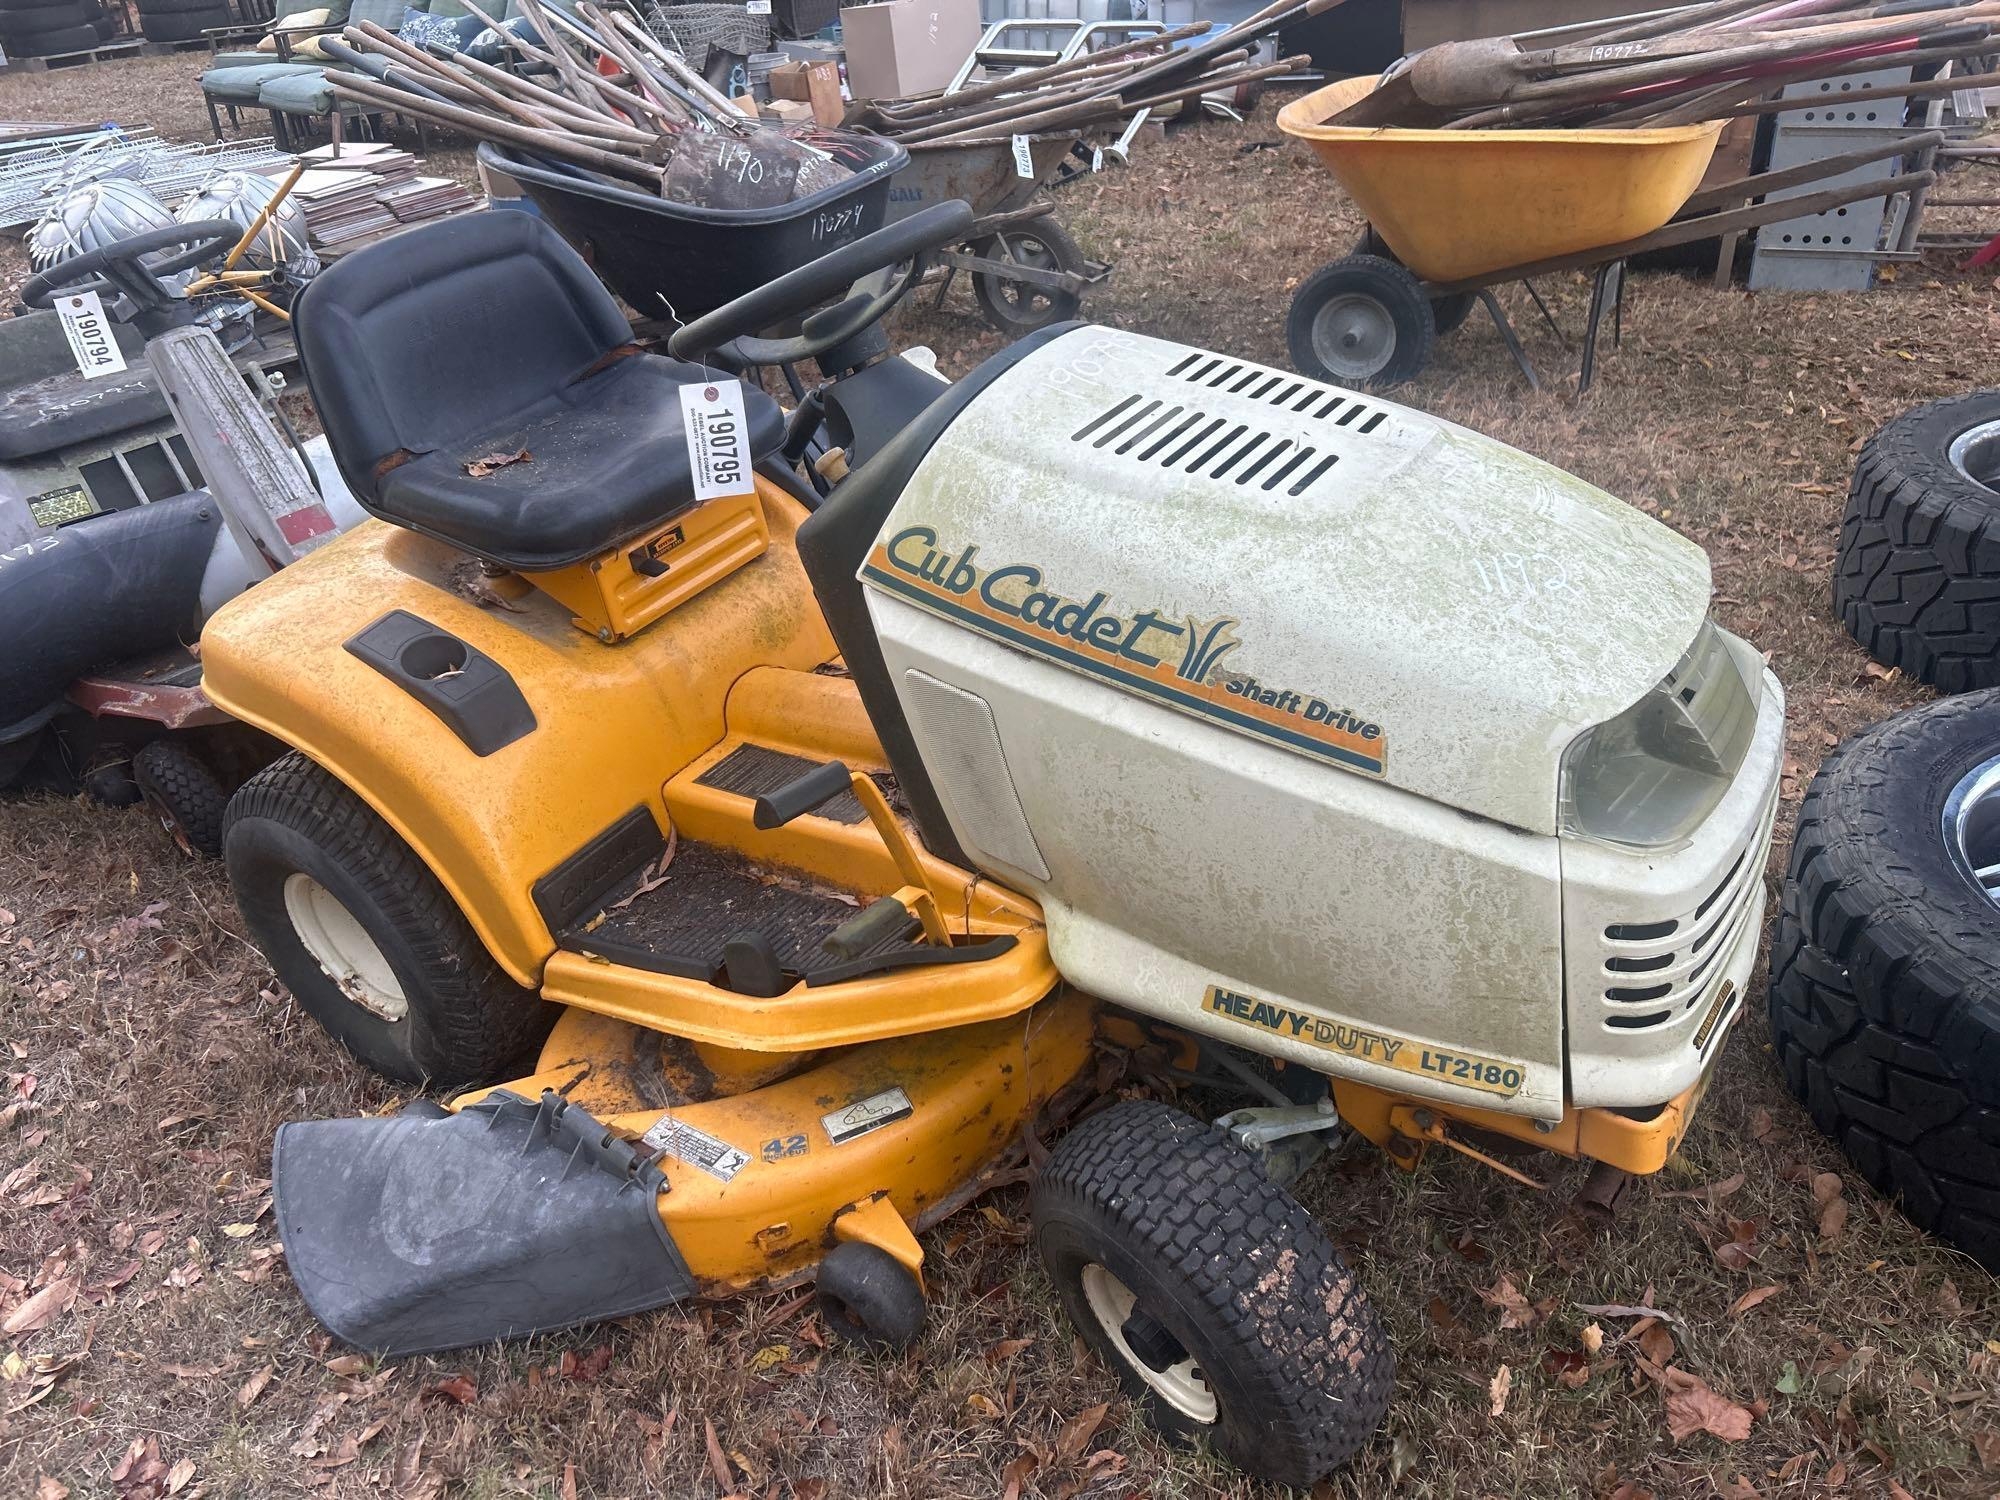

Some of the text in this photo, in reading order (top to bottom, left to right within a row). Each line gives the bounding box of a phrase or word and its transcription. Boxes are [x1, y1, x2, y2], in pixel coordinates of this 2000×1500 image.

[1589, 44, 1649, 62] 190772
[718, 142, 763, 184] 1190
[811, 204, 864, 241] 190774
[75, 310, 113, 366] 190794
[698, 412, 712, 483] REBEL AUCTION COMPANY
[707, 408, 741, 484] 190795
[0, 535, 60, 569] 193
[1472, 552, 1583, 598] 1192
[886, 525, 1186, 668] Cub Cadet
[1303, 700, 1381, 740] Drive
[1213, 988, 1520, 1089] HEAVY-DUTY LT2180
[763, 1134, 807, 1152] 42
[787, 1148, 808, 1159] CUT
